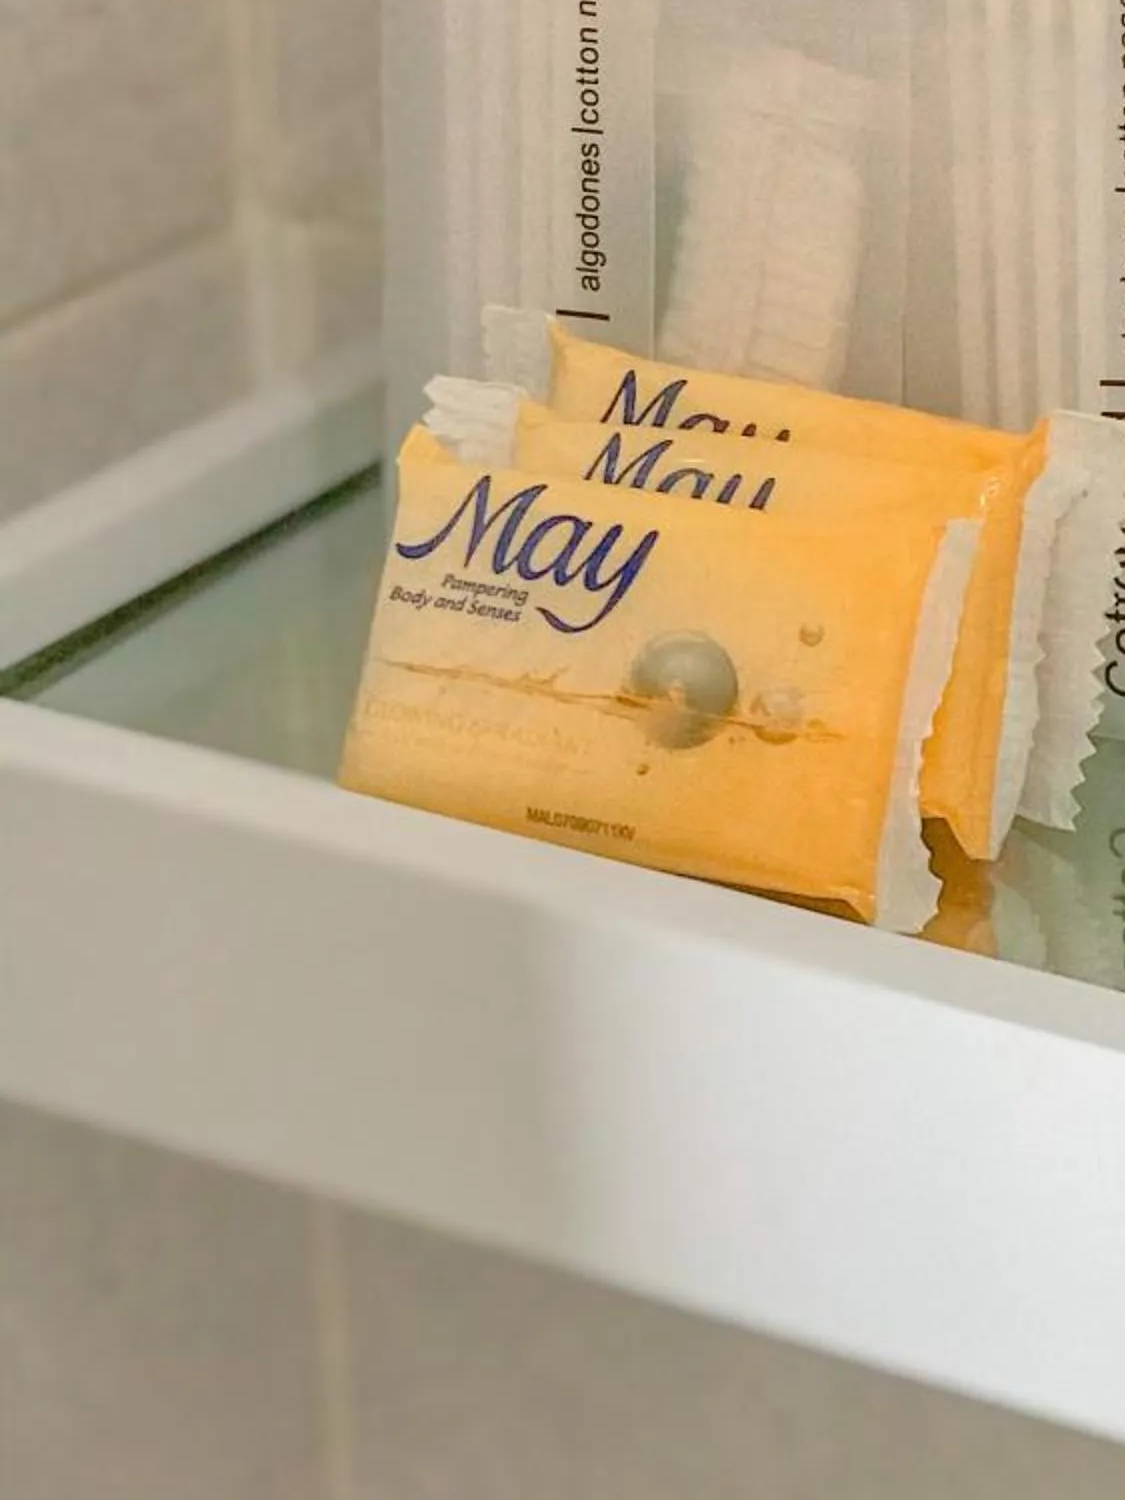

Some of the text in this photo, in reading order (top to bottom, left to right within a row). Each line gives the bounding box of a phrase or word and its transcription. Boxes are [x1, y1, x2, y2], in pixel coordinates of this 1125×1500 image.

[575, 26, 601, 126] cotton
[575, 140, 607, 292] algodones
[388, 585, 522, 623] Body and Senses
[394, 474, 661, 634] May
[441, 573, 530, 607] Pampering
